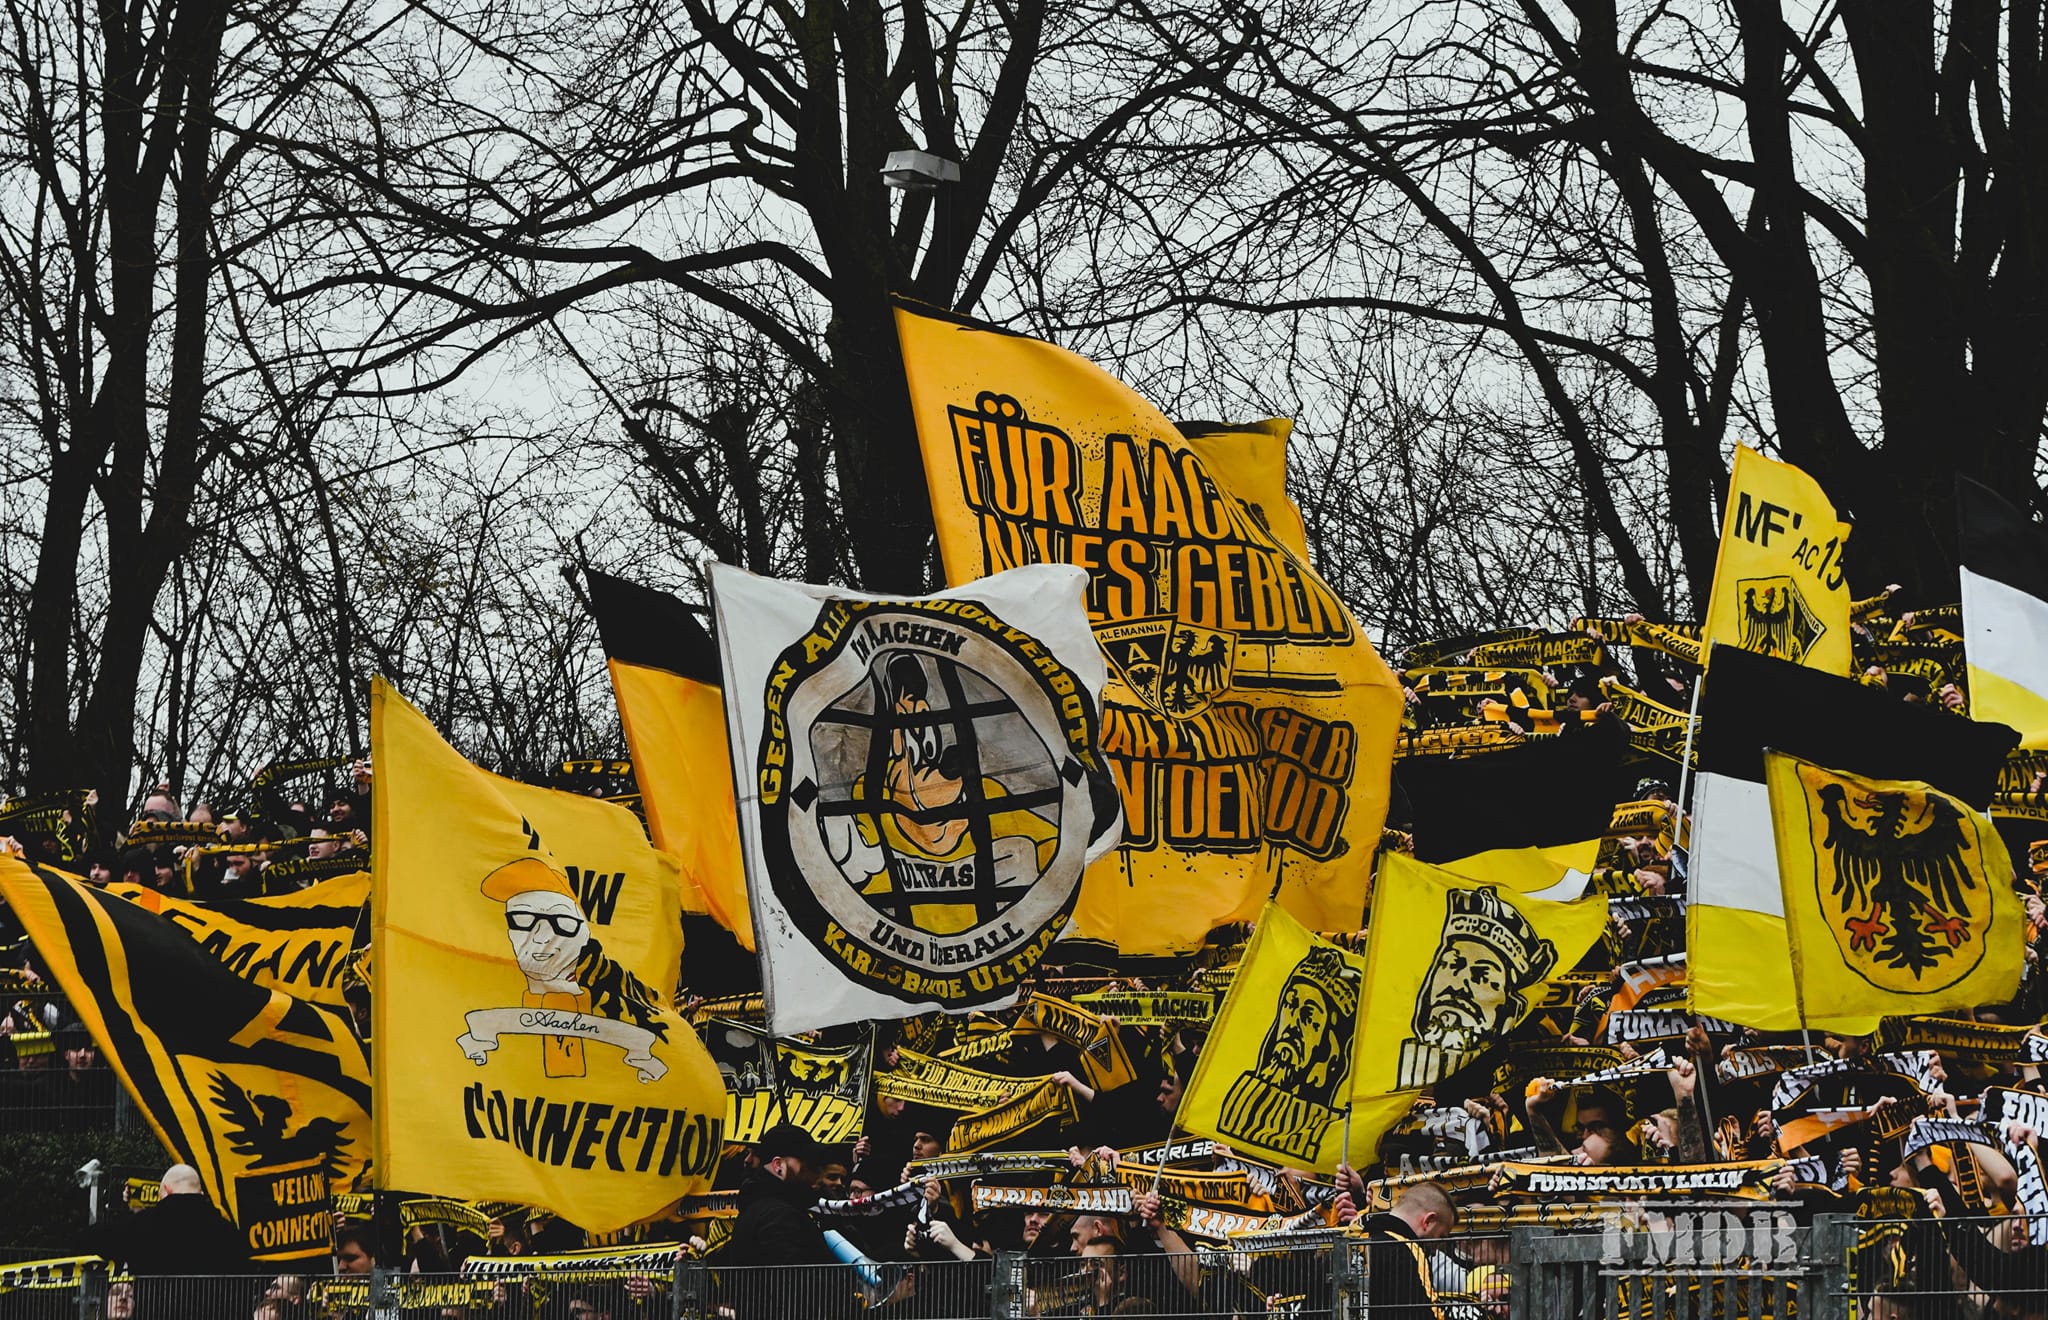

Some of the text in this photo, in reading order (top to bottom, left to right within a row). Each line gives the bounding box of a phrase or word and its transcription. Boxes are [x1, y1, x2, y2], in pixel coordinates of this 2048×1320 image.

[949, 391, 1081, 527] FÜR
[1792, 537, 1820, 570] AC
[1174, 542, 1354, 642] GEBEN
[863, 618, 968, 658] AACHEN
[1099, 624, 1167, 641] ALEMANNIA
[1127, 642, 1151, 664] A
[760, 660, 798, 806] GEGEN
[1257, 706, 1354, 785] GELB
[1166, 757, 1263, 845] DEN
[267, 860, 296, 877] TSV
[869, 919, 1026, 967] UND ÜBERALL
[967, 913, 1070, 993] ULTRAS
[518, 1011, 601, 1035] Aachen
[1151, 999, 1210, 1019] AACHEN
[1904, 1026, 2022, 1050] LEMANNIA
[919, 1060, 945, 1083] FÜR
[945, 1073, 990, 1093] AACHEN
[1073, 1189, 1133, 1213] BAND
